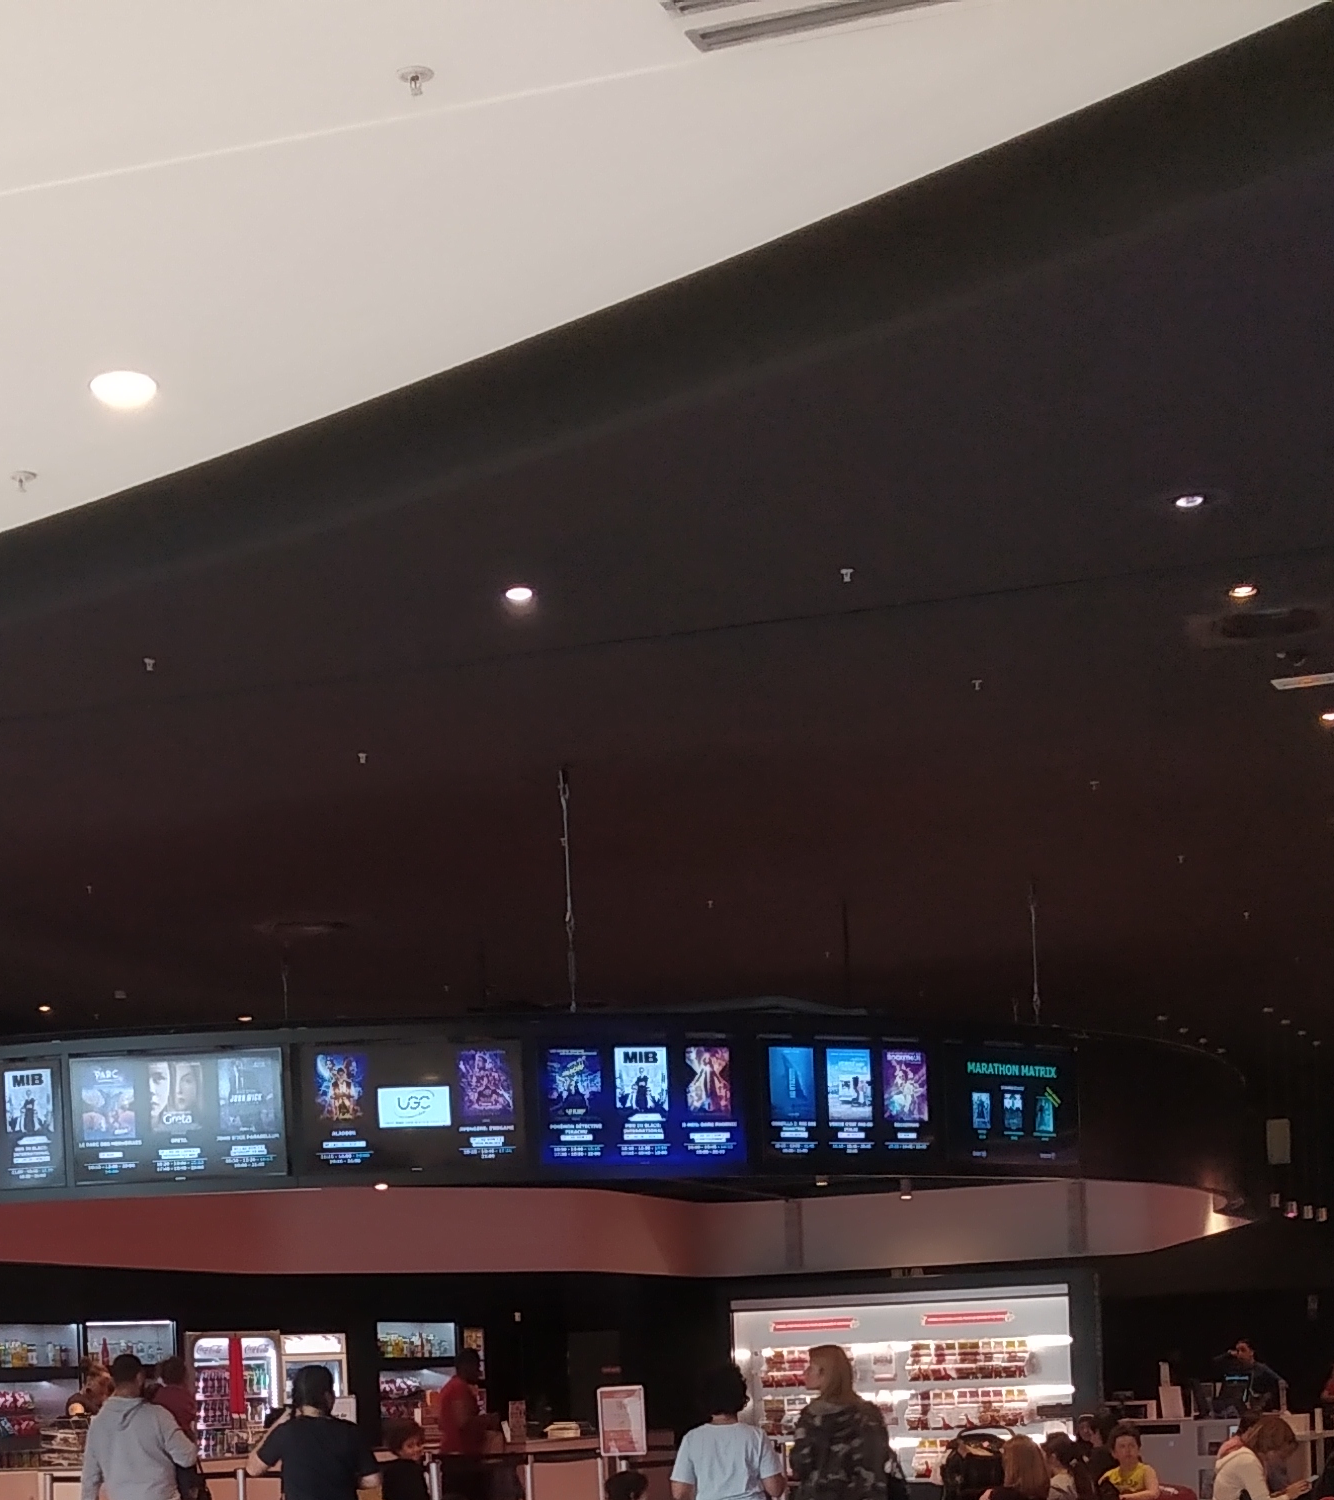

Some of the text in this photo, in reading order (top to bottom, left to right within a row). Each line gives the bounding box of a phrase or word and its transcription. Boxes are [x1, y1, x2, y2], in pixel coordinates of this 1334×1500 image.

[623, 1050, 659, 1064] MIB
[967, 1061, 1057, 1078] MARATHON MATRIX
[12, 1073, 44, 1087] MIB
[397, 1095, 431, 1111] UGC
[163, 1113, 192, 1125] Greta
